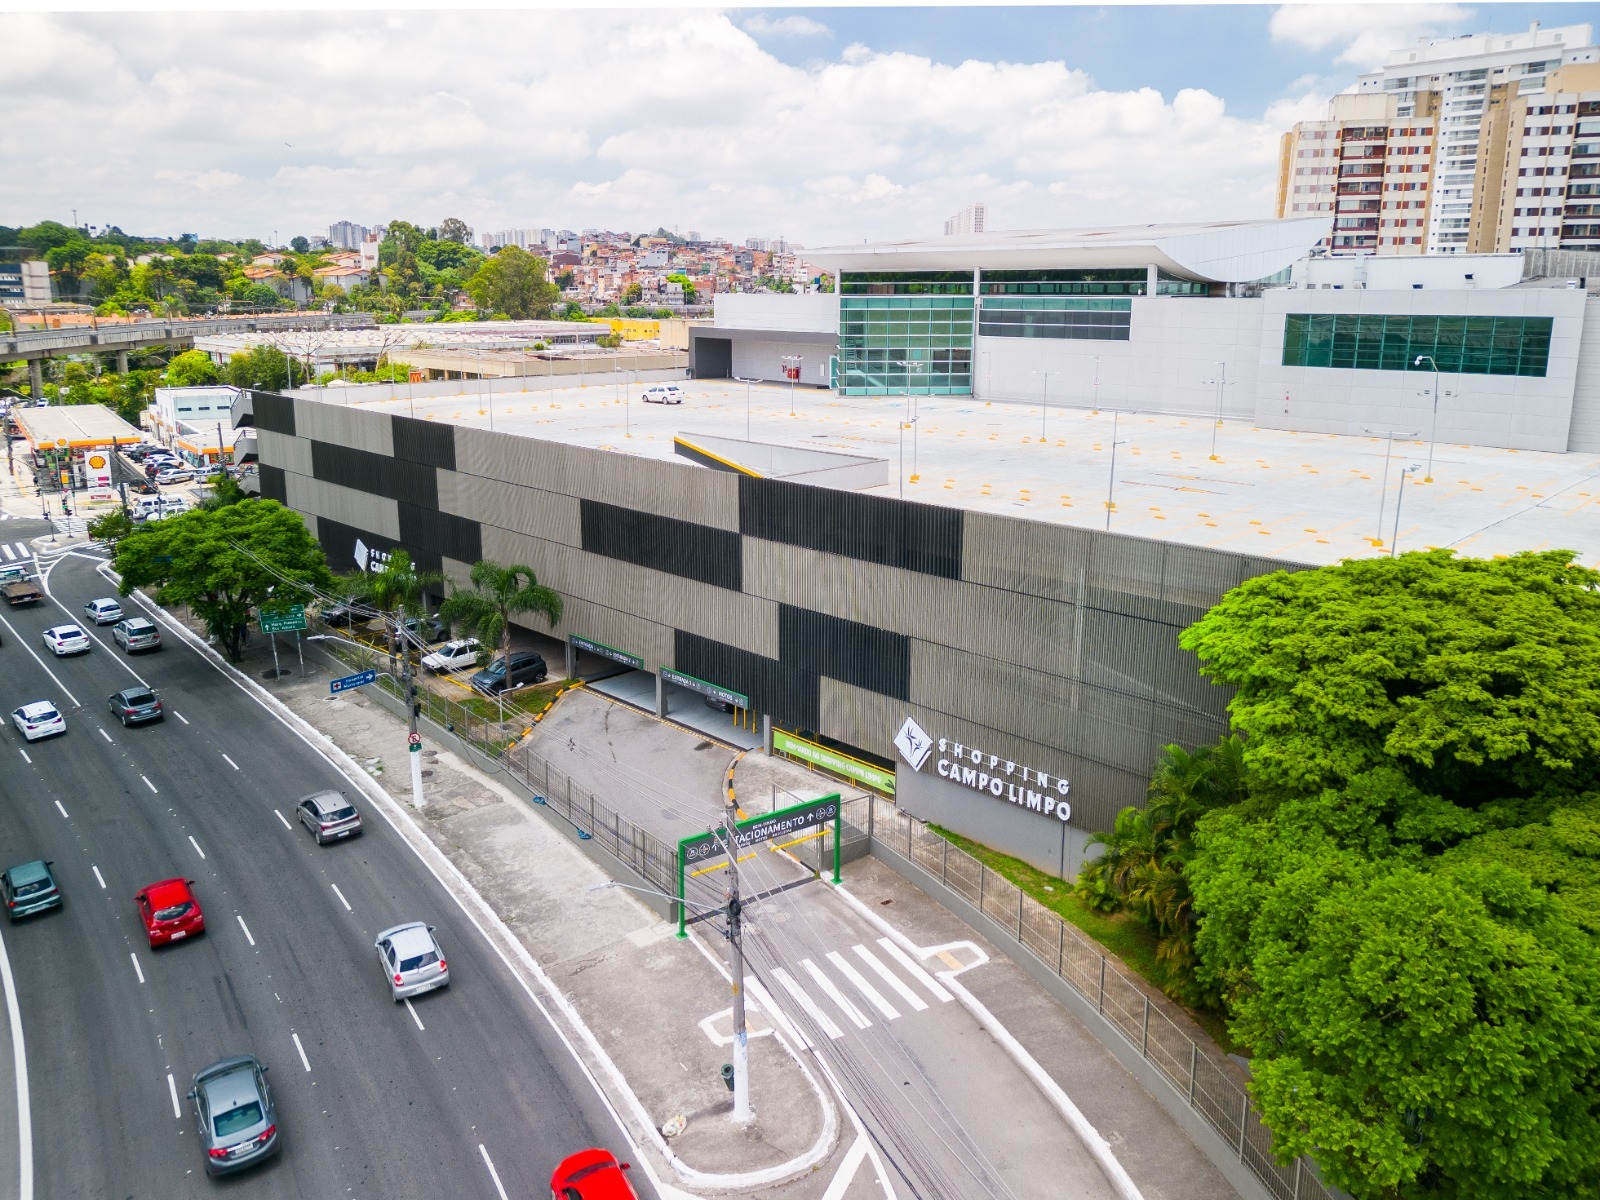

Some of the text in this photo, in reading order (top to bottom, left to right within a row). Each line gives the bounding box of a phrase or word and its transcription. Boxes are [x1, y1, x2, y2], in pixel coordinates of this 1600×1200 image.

[937, 758, 1072, 822] CAMPO LIMPO
[938, 737, 1070, 796] SHOPPING
